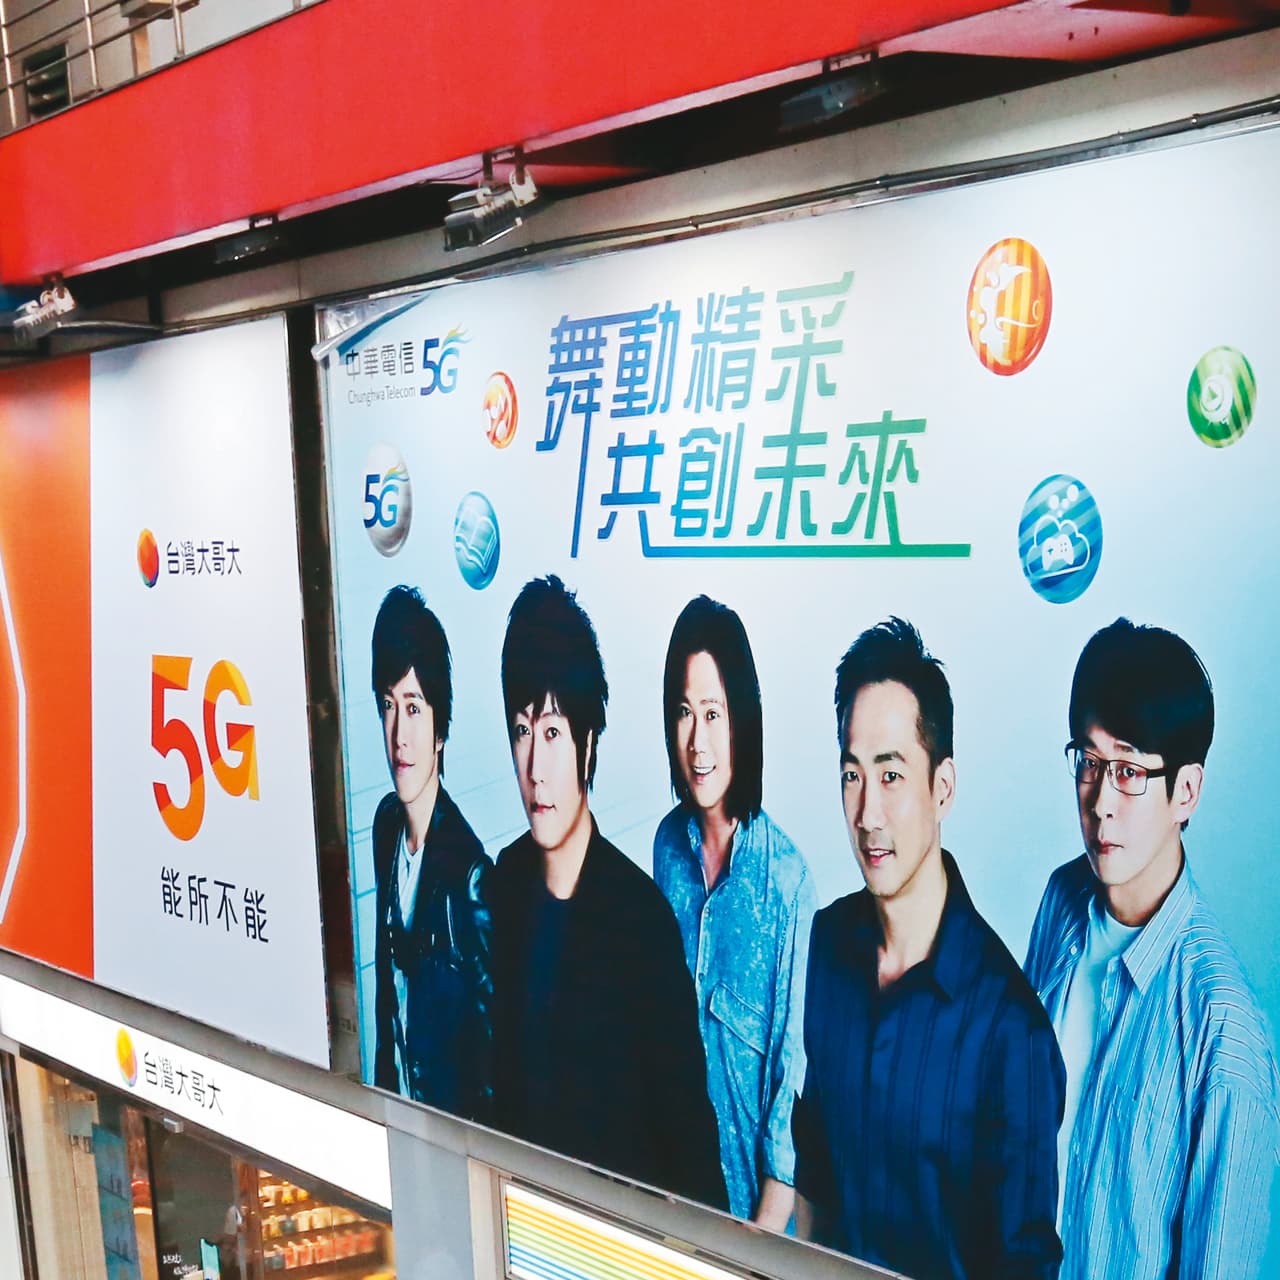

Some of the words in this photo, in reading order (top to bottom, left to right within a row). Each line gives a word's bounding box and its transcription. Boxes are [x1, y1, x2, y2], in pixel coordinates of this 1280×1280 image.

[345, 341, 415, 381] 中華電信
[420, 337, 460, 396] 5G
[348, 387, 385, 407] Chunghwa
[385, 385, 416, 400] Telecom
[535, 270, 855, 558] 舞動精采
[363, 473, 399, 528] 5G
[598, 410, 971, 559] 共創未來
[166, 540, 242, 577] 台灣大哥大
[151, 654, 260, 842] 5G
[160, 866, 269, 944] 能所不能
[143, 1051, 224, 1115] 台灣大哥大
